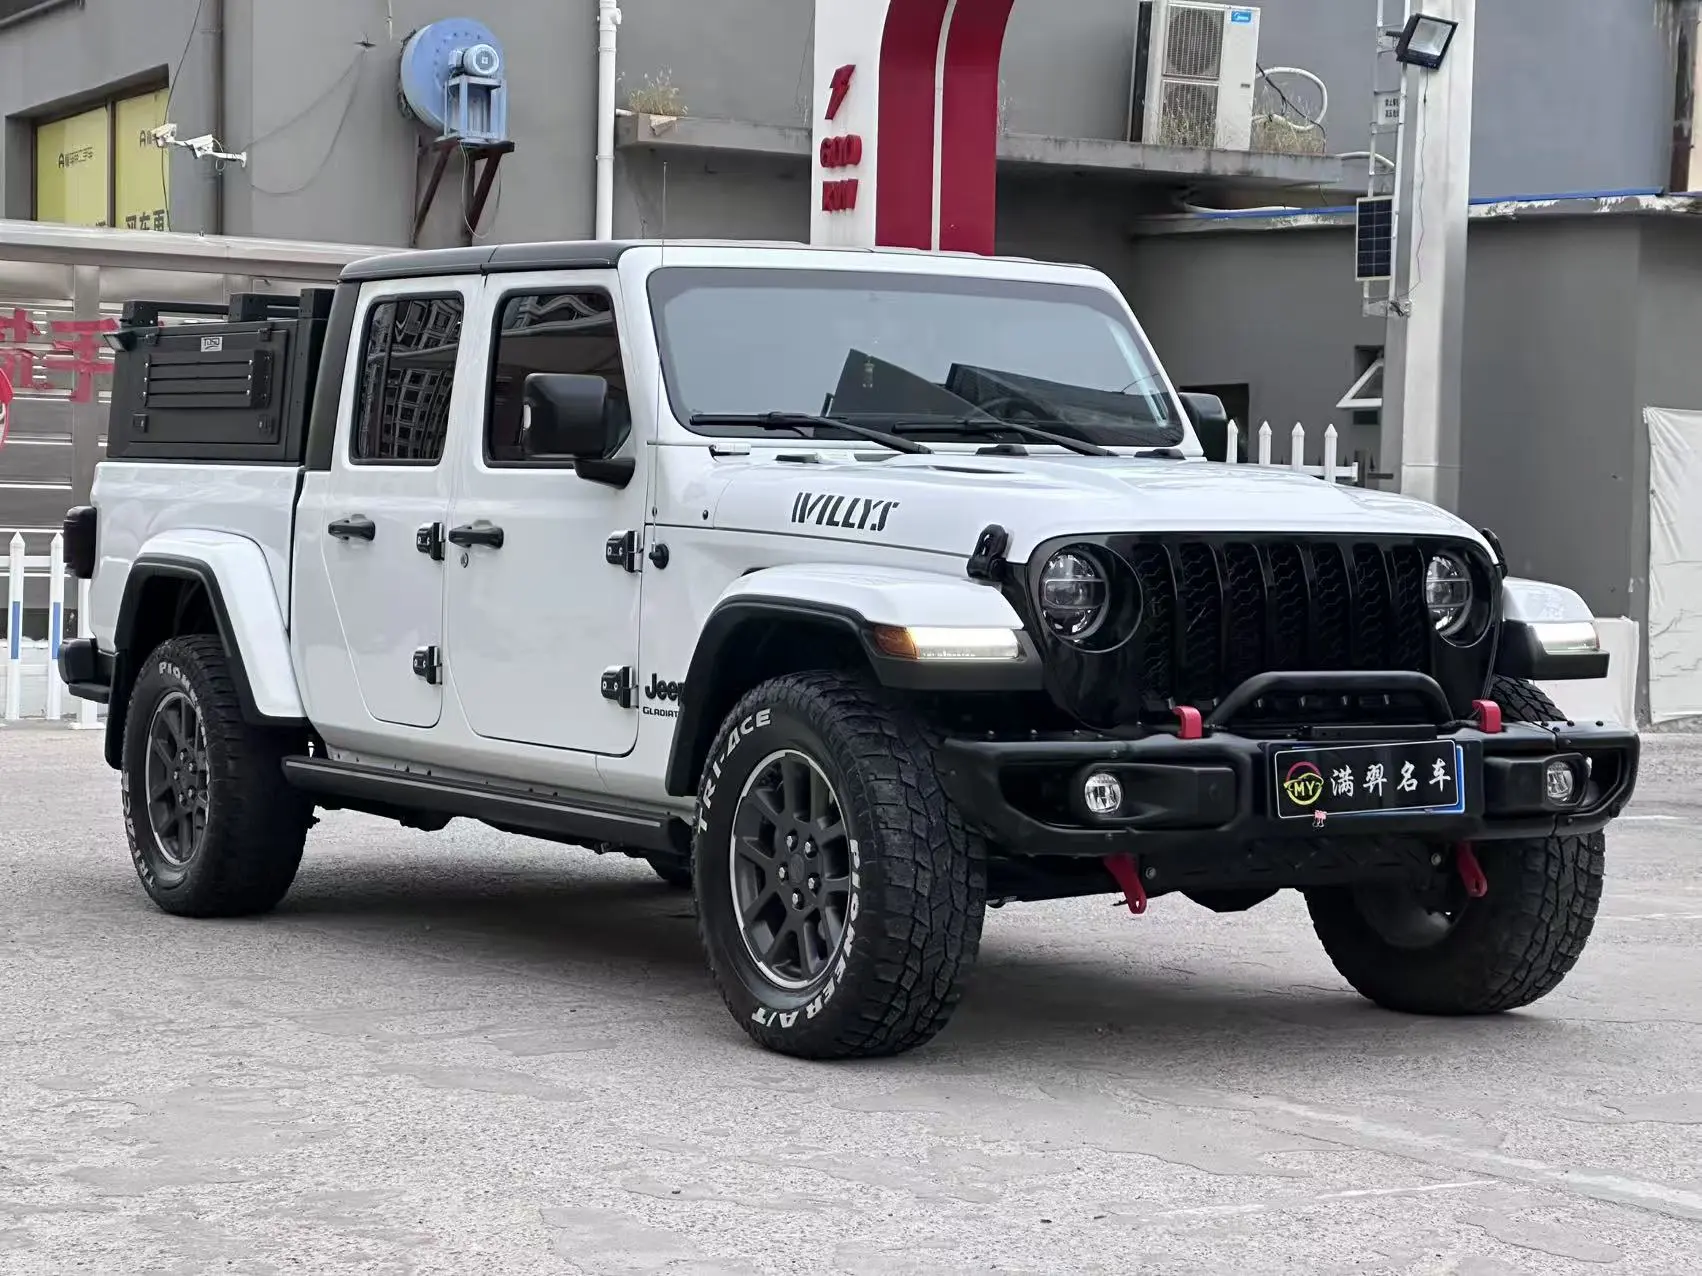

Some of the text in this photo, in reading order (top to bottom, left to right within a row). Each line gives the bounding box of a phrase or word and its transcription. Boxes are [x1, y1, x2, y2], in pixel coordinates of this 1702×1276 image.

[791, 491, 900, 532] WILLYS
[642, 706, 680, 717] GLADIAT
[698, 708, 772, 834] TRI-ACE
[752, 1006, 799, 1028] A/T
